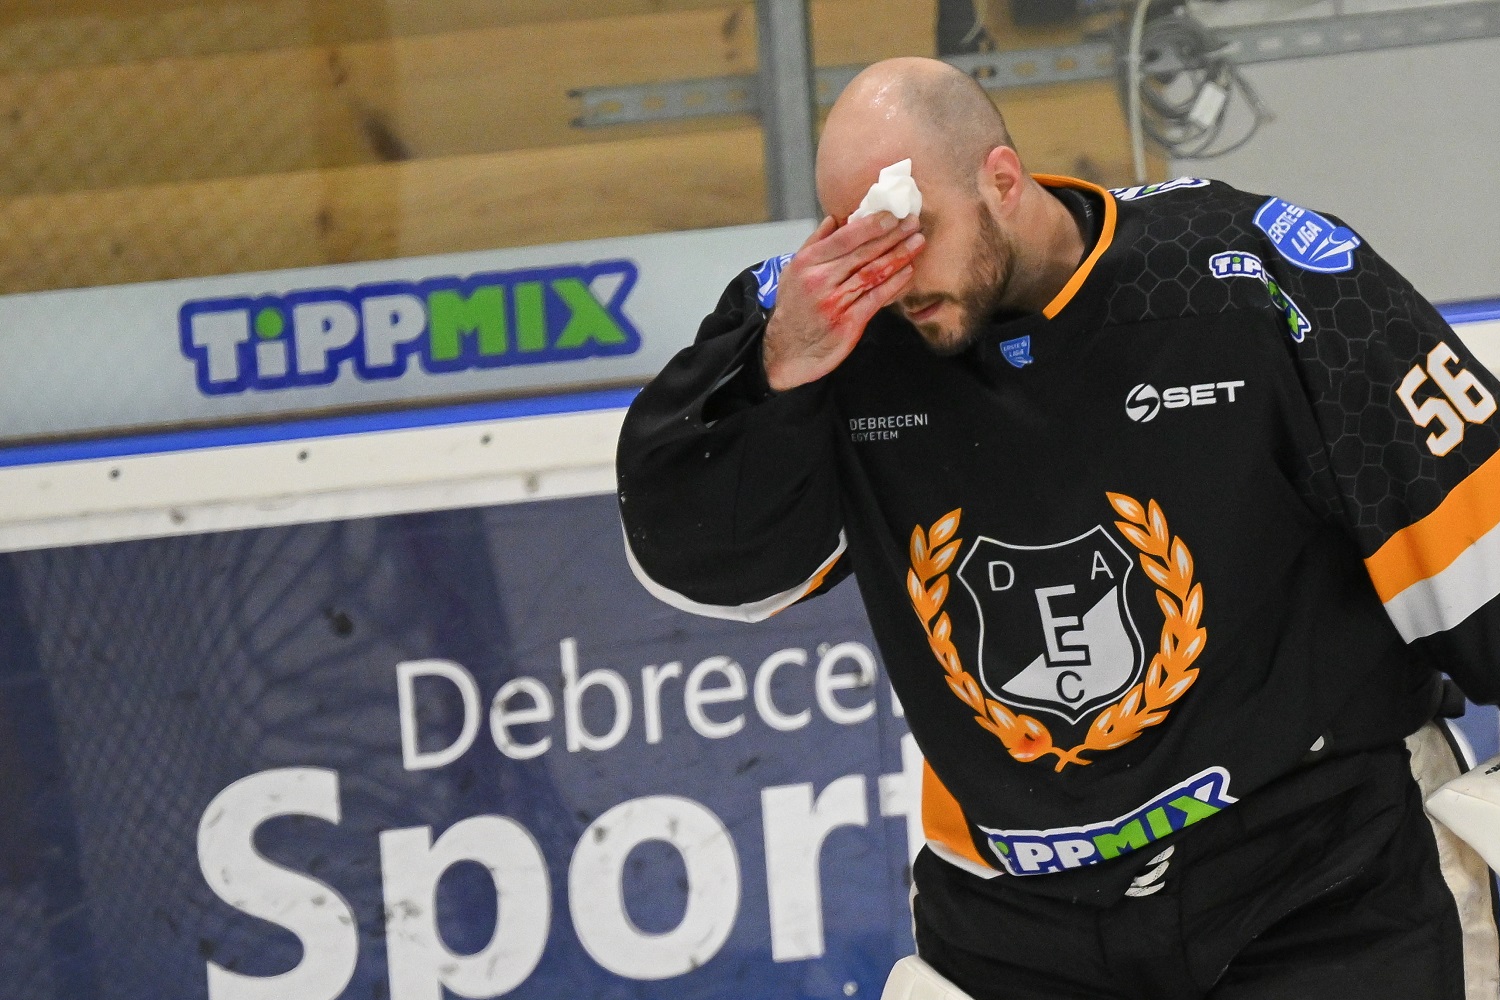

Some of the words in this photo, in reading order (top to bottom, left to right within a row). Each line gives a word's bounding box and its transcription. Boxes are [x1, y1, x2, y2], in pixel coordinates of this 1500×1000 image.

[1268, 211, 1298, 245] ERSTE
[1291, 220, 1323, 255] LIGA
[1162, 380, 1246, 409] SET
[1396, 341, 1498, 457] 56
[849, 413, 928, 431] DEBRECENI
[851, 430, 898, 442] EGYETEM
[396, 637, 905, 770] Debrece
